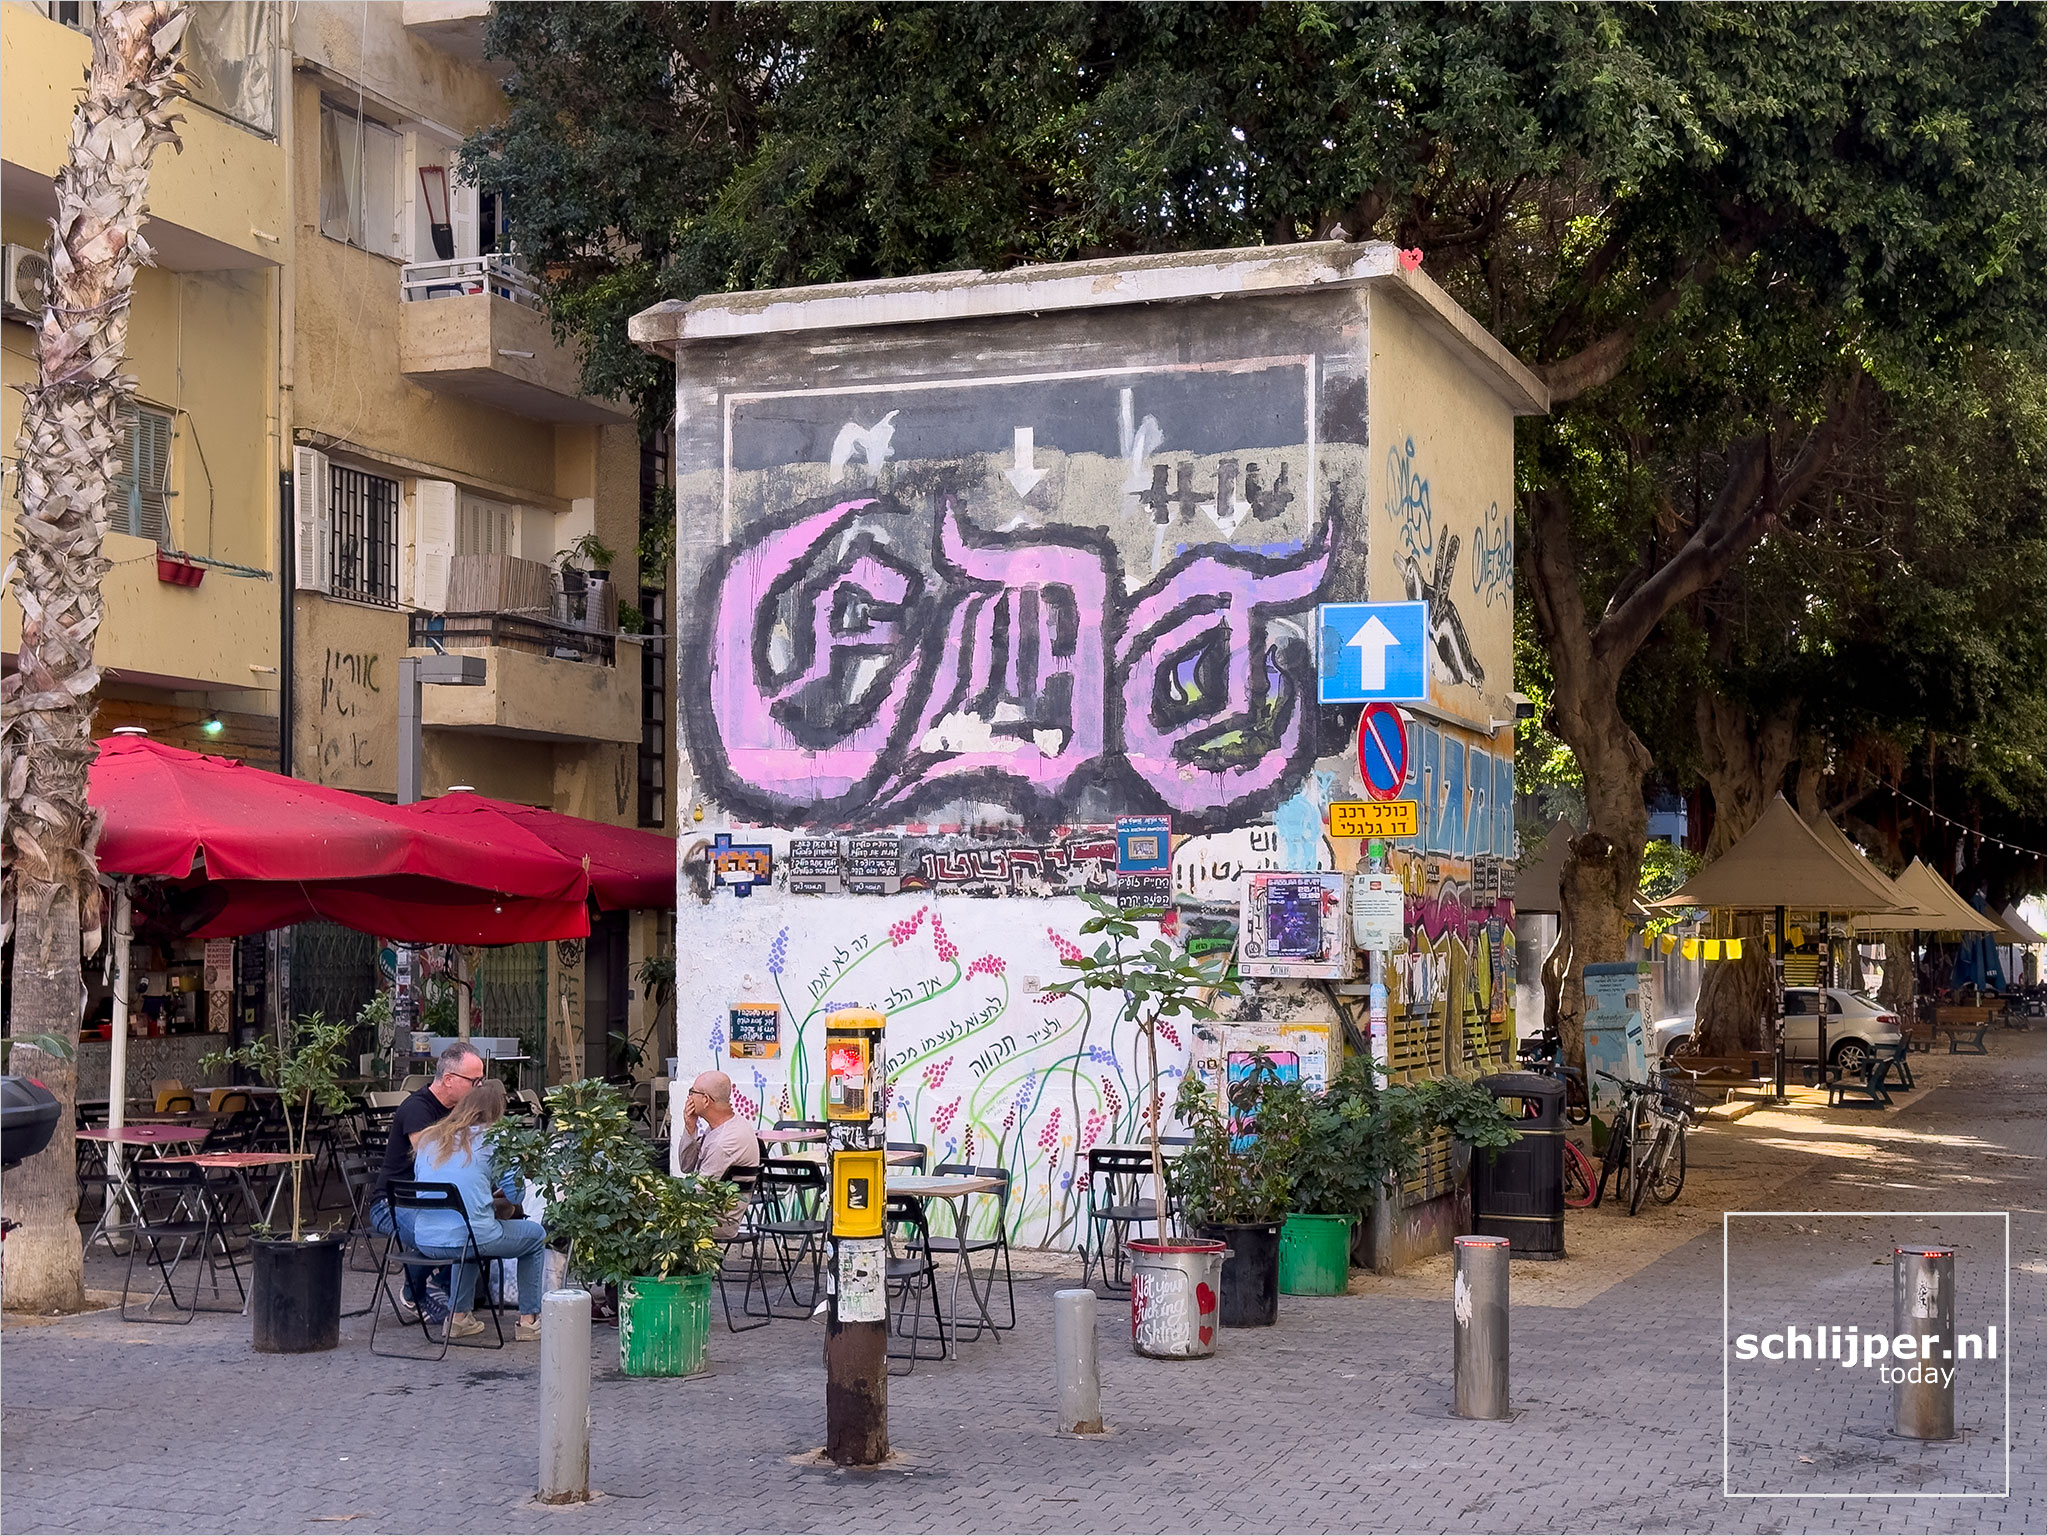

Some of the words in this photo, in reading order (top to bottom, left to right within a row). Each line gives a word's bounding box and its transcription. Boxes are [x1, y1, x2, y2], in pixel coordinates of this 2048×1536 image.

[1338, 807, 1366, 819] רכב
[1373, 805, 1407, 818] כולל
[1341, 822, 1383, 834] גלגלי
[1391, 822, 1406, 833] דו
[851, 934, 869, 952] זה
[832, 945, 850, 975] לא
[807, 966, 832, 1001] יאמן
[917, 976, 942, 998] איך
[884, 986, 914, 1009] הלב
[965, 997, 1004, 1034] למצוא
[921, 1020, 963, 1052] לעצמו
[969, 1035, 1017, 1078] תקווה
